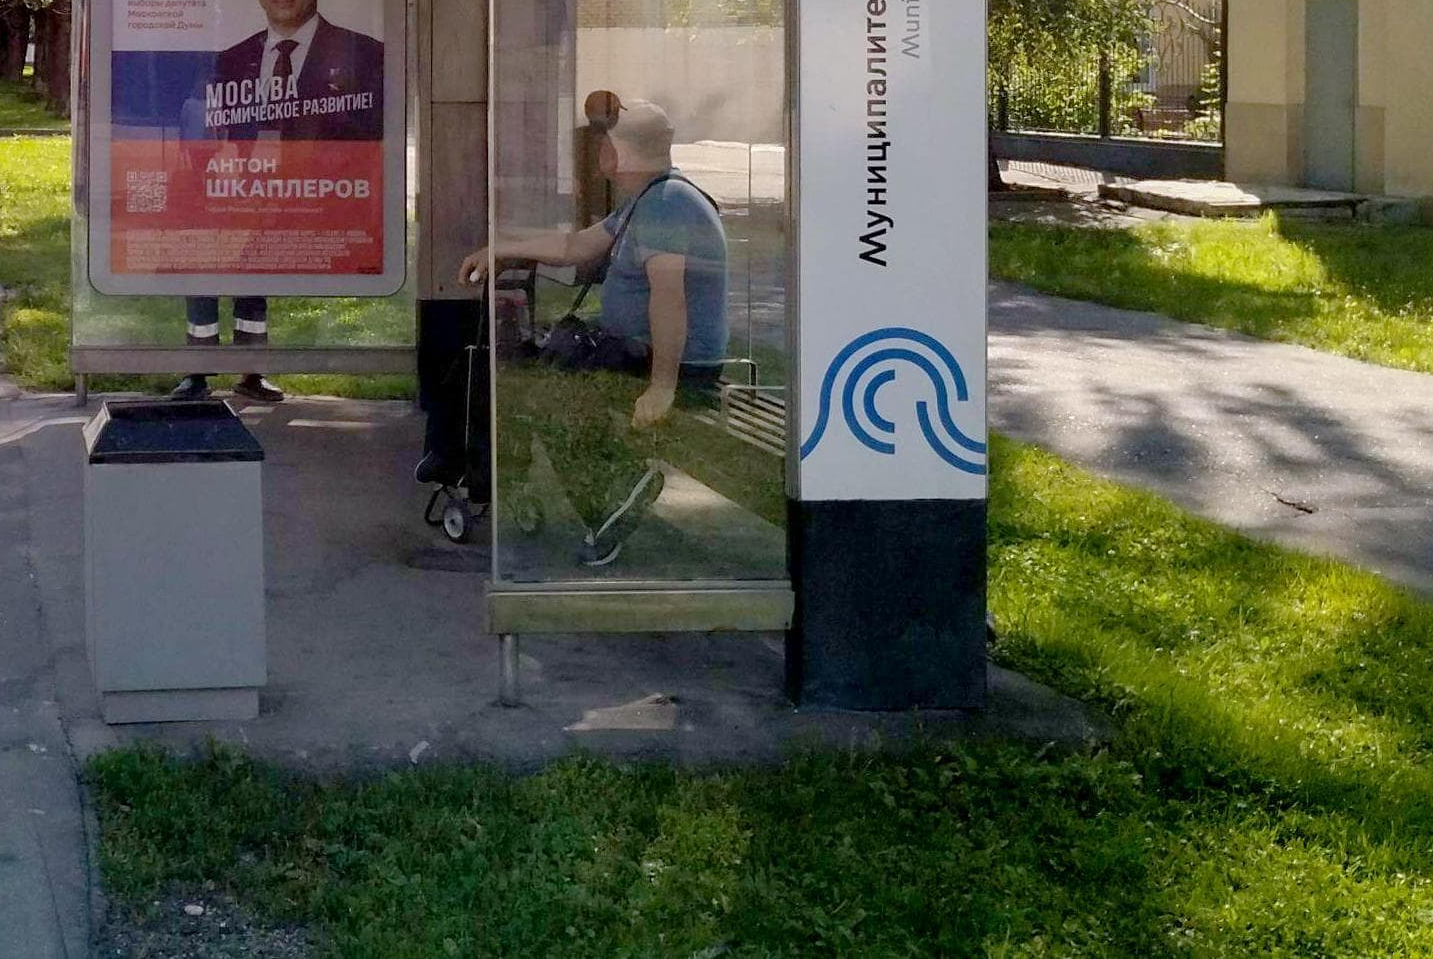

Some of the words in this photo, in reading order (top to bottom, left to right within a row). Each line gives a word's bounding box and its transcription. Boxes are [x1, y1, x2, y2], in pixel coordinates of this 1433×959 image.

[205, 75, 299, 109] МОСКВА
[205, 100, 300, 128] КОСМИЧЕСКОЕ
[302, 92, 374, 117] РАЗВИТИЕ!
[205, 158, 277, 174] АНТОН
[206, 179, 370, 199] ШКАПЛЕРОВ
